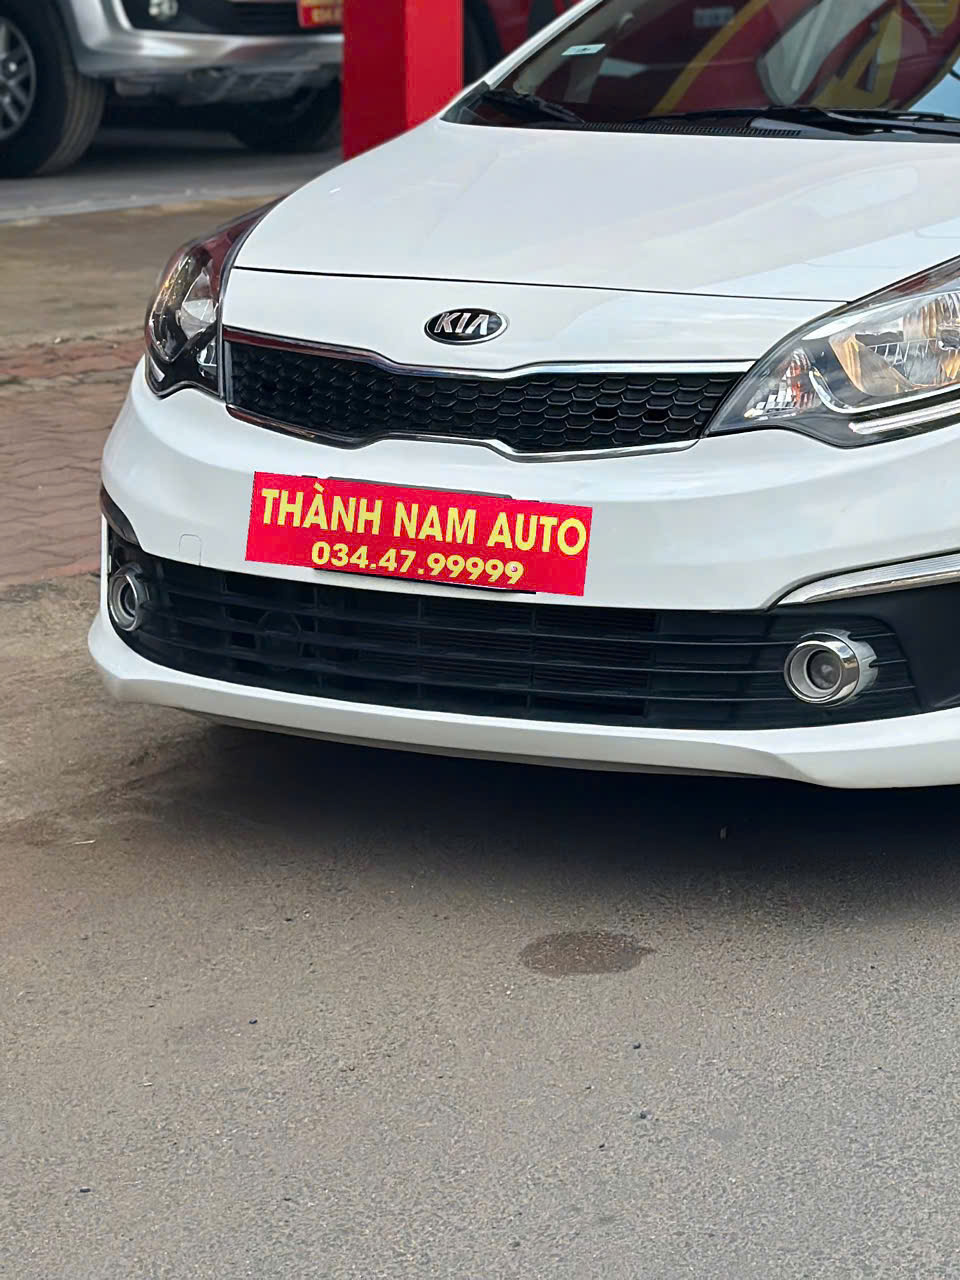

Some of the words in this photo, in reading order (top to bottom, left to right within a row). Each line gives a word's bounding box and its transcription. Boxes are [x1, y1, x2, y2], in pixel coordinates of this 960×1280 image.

[434, 312, 489, 335] KIA
[261, 482, 383, 535] THÀNH
[392, 501, 477, 545] NAM
[487, 510, 587, 556] AUTO
[311, 541, 524, 585] 034.47.99999
